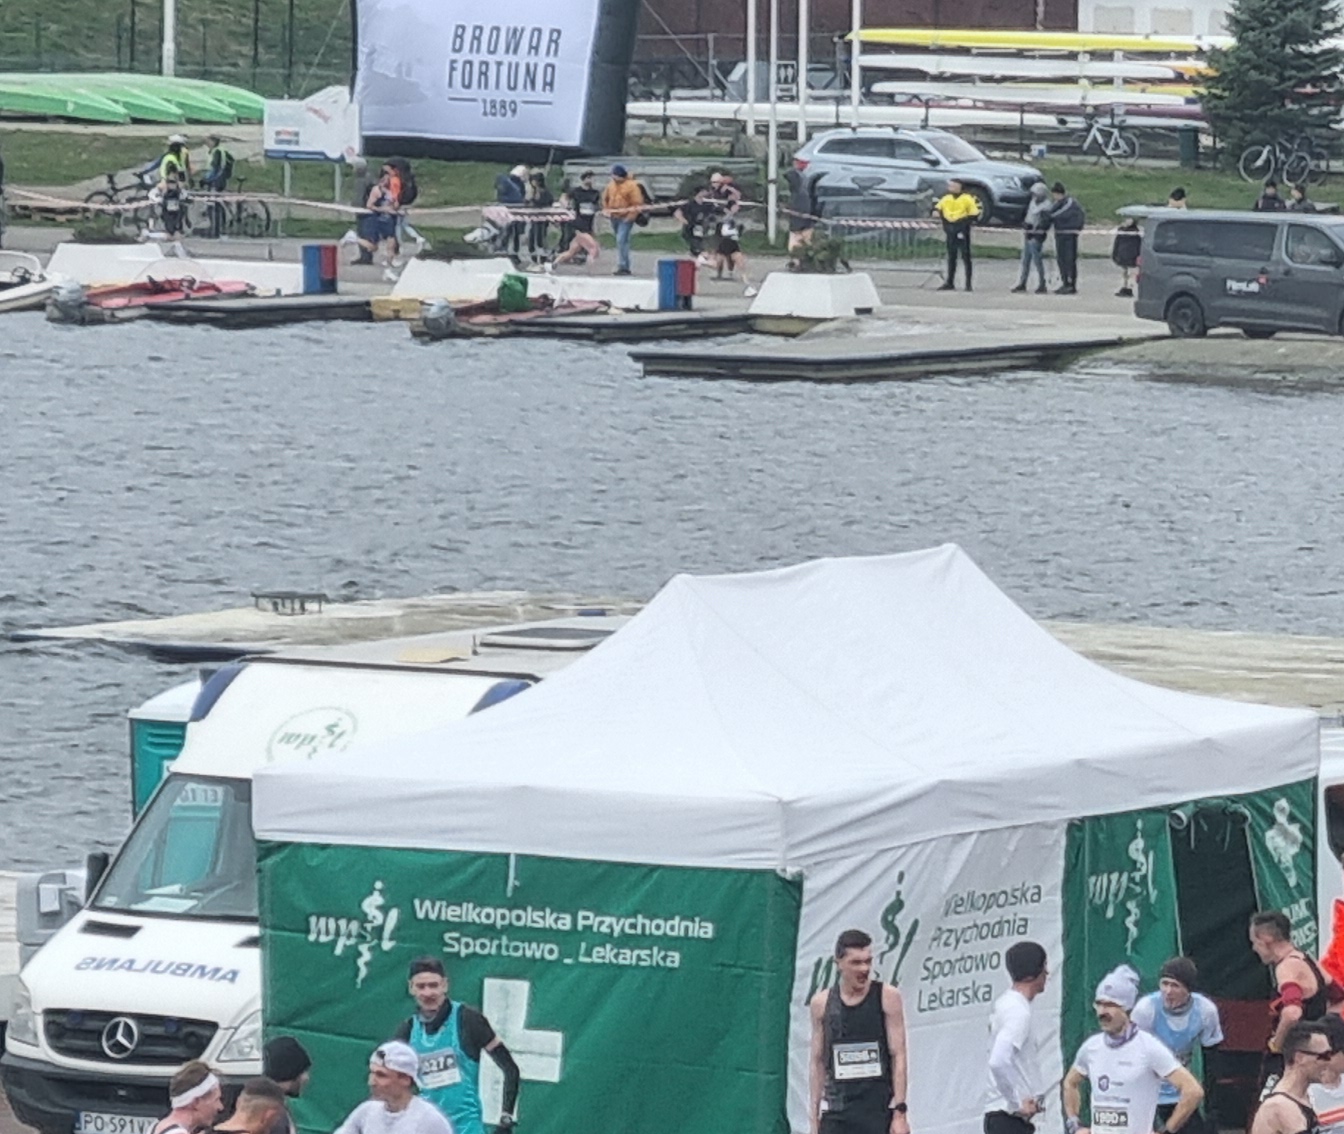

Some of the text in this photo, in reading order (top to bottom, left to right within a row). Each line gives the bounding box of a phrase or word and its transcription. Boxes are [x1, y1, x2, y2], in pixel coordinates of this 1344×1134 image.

[451, 24, 562, 57] BROWAR
[448, 59, 556, 93] FORTUNA
[481, 98, 518, 118] 1889
[413, 898, 714, 939] Wielkopolska Przychodnia
[442, 931, 559, 962] Sportowo
[578, 941, 681, 969] Lekarska
[920, 950, 1002, 985] Sportowo
[917, 980, 993, 1013] Lekarska
[82, 1113, 105, 1132] PO
